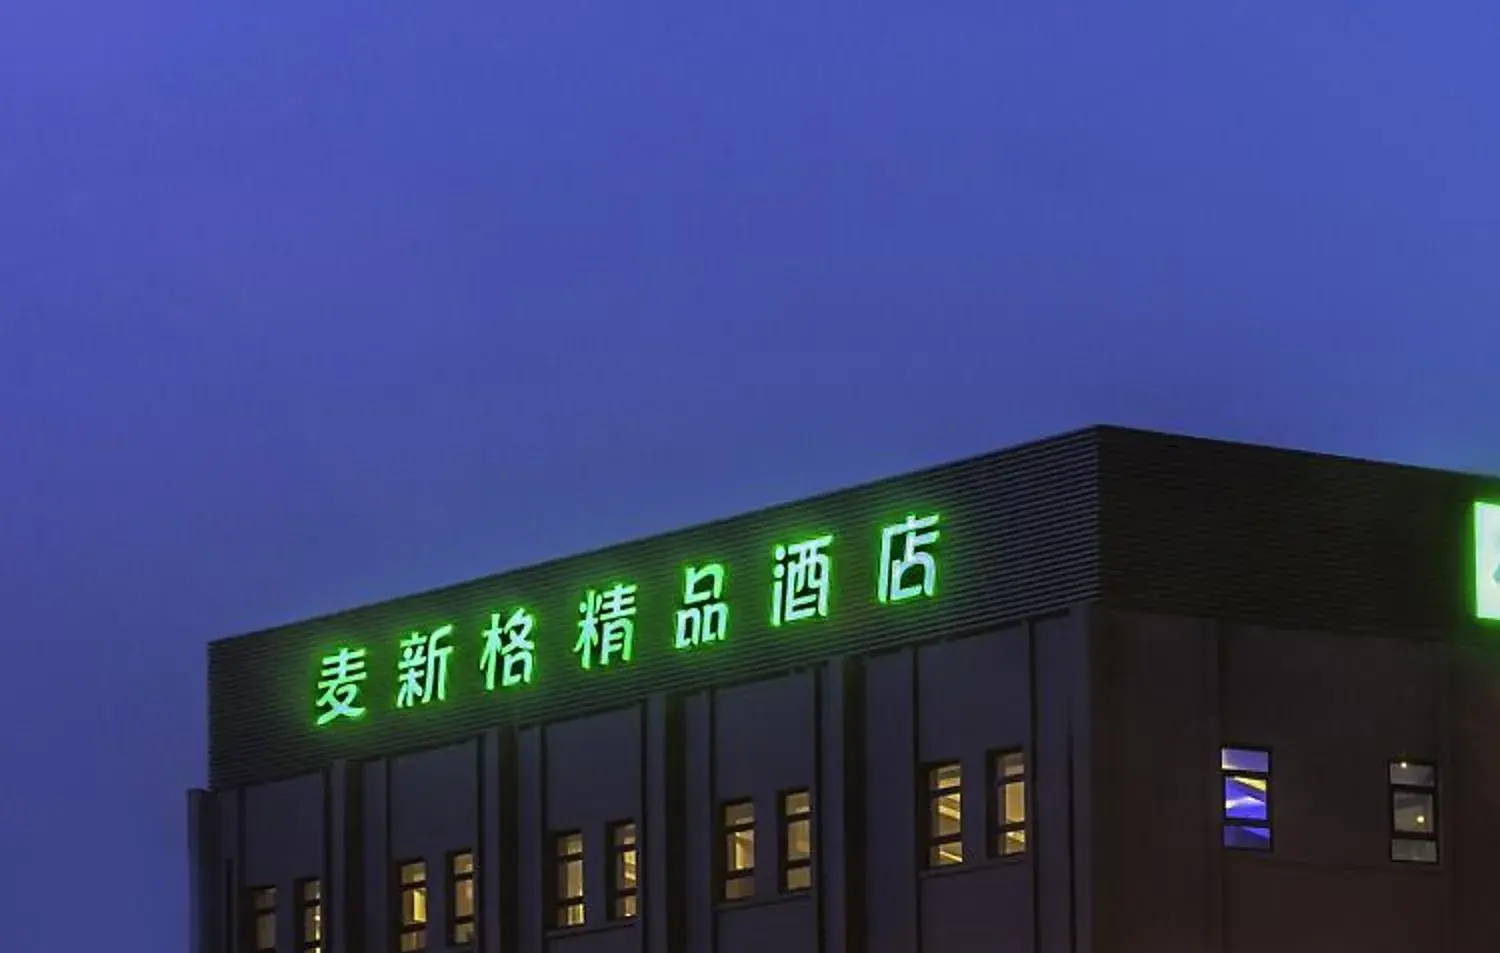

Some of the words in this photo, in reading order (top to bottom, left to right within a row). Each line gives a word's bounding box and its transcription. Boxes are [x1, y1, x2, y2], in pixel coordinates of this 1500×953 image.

[316, 513, 940, 725] 麦新格精品酒店
